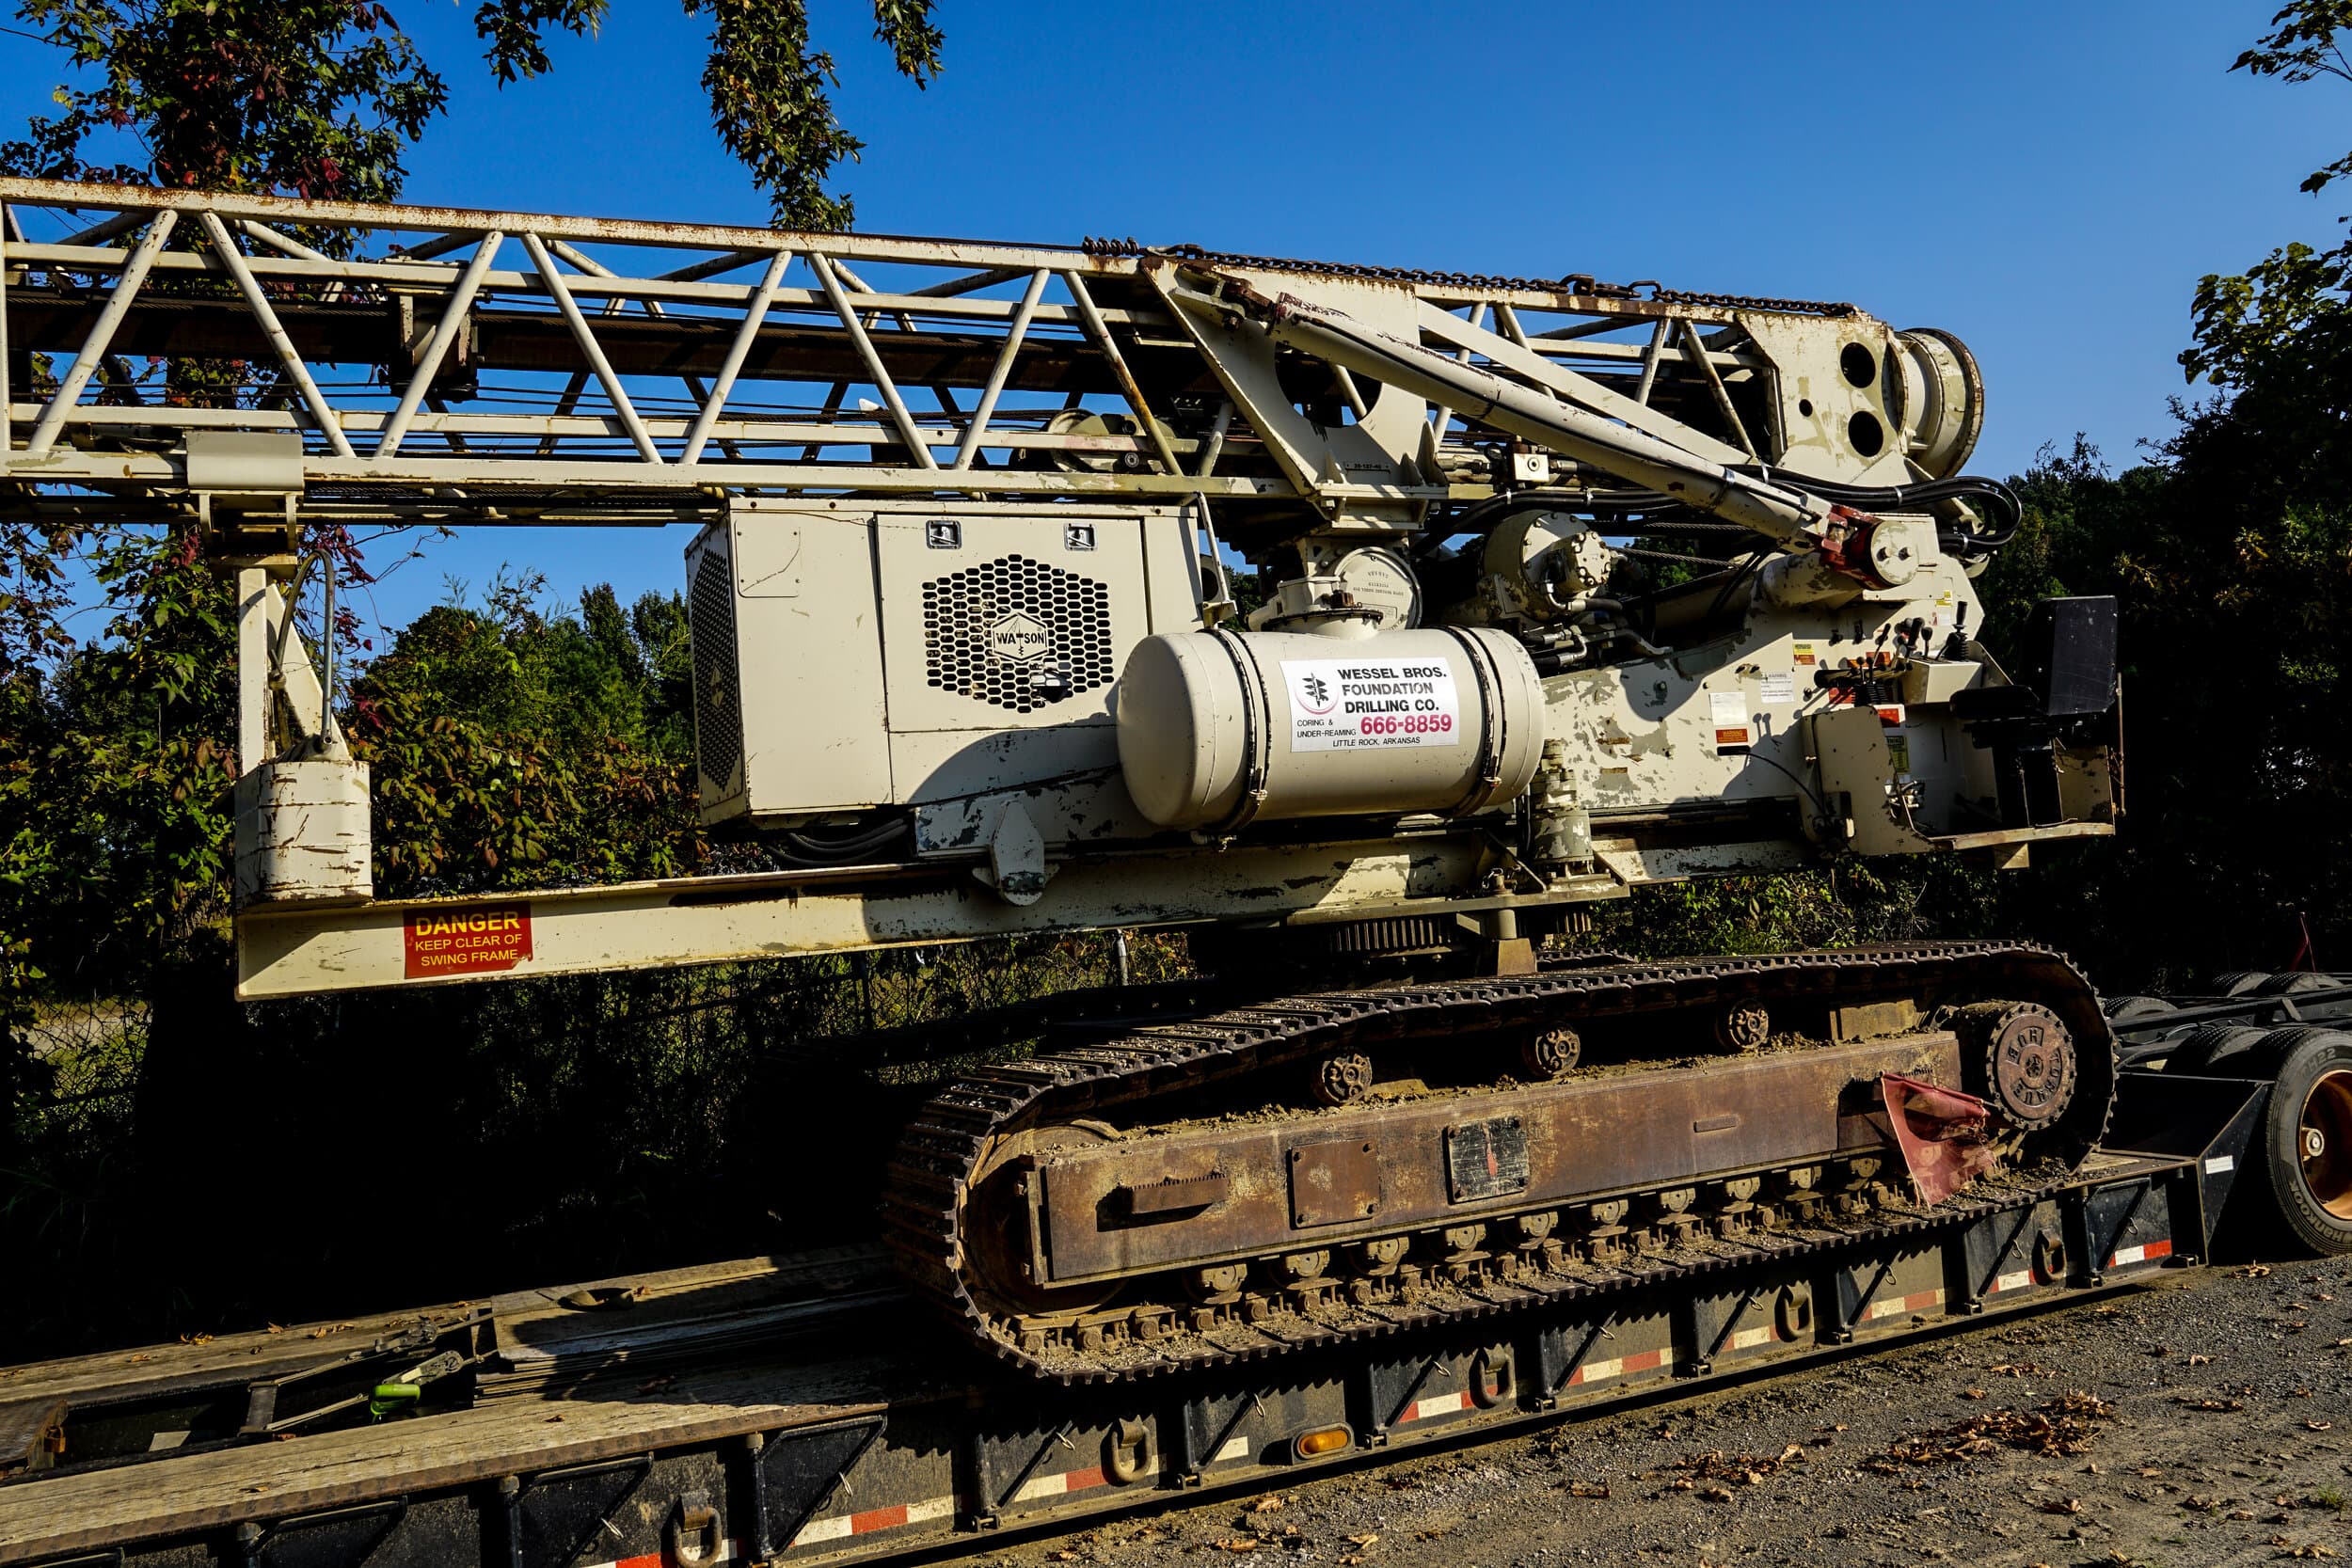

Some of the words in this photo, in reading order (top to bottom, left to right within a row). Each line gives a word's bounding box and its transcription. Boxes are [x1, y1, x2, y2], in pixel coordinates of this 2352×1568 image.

[995, 632, 1044, 644] WATSON
[1337, 668, 1399, 680] WESSEL
[1403, 666, 1447, 679] BROS.
[1342, 682, 1434, 696] FOUNDATION
[1345, 700, 1409, 714] DRILLING
[1414, 698, 1439, 712] CO.
[1296, 719, 1325, 727] CORING
[1360, 713, 1453, 735] 666-8859
[1296, 728, 1357, 738] UNDER-REAMING
[1359, 737, 1380, 746] ROCK,
[1383, 736, 1421, 745] ARKANSAS
[416, 911, 520, 936] DANGER
[415, 939, 452, 952] KEEP
[455, 935, 501, 949] CLEAR
[503, 933, 523, 944] OF
[421, 952, 468, 967] SWING
[471, 948, 518, 963] FRAME
